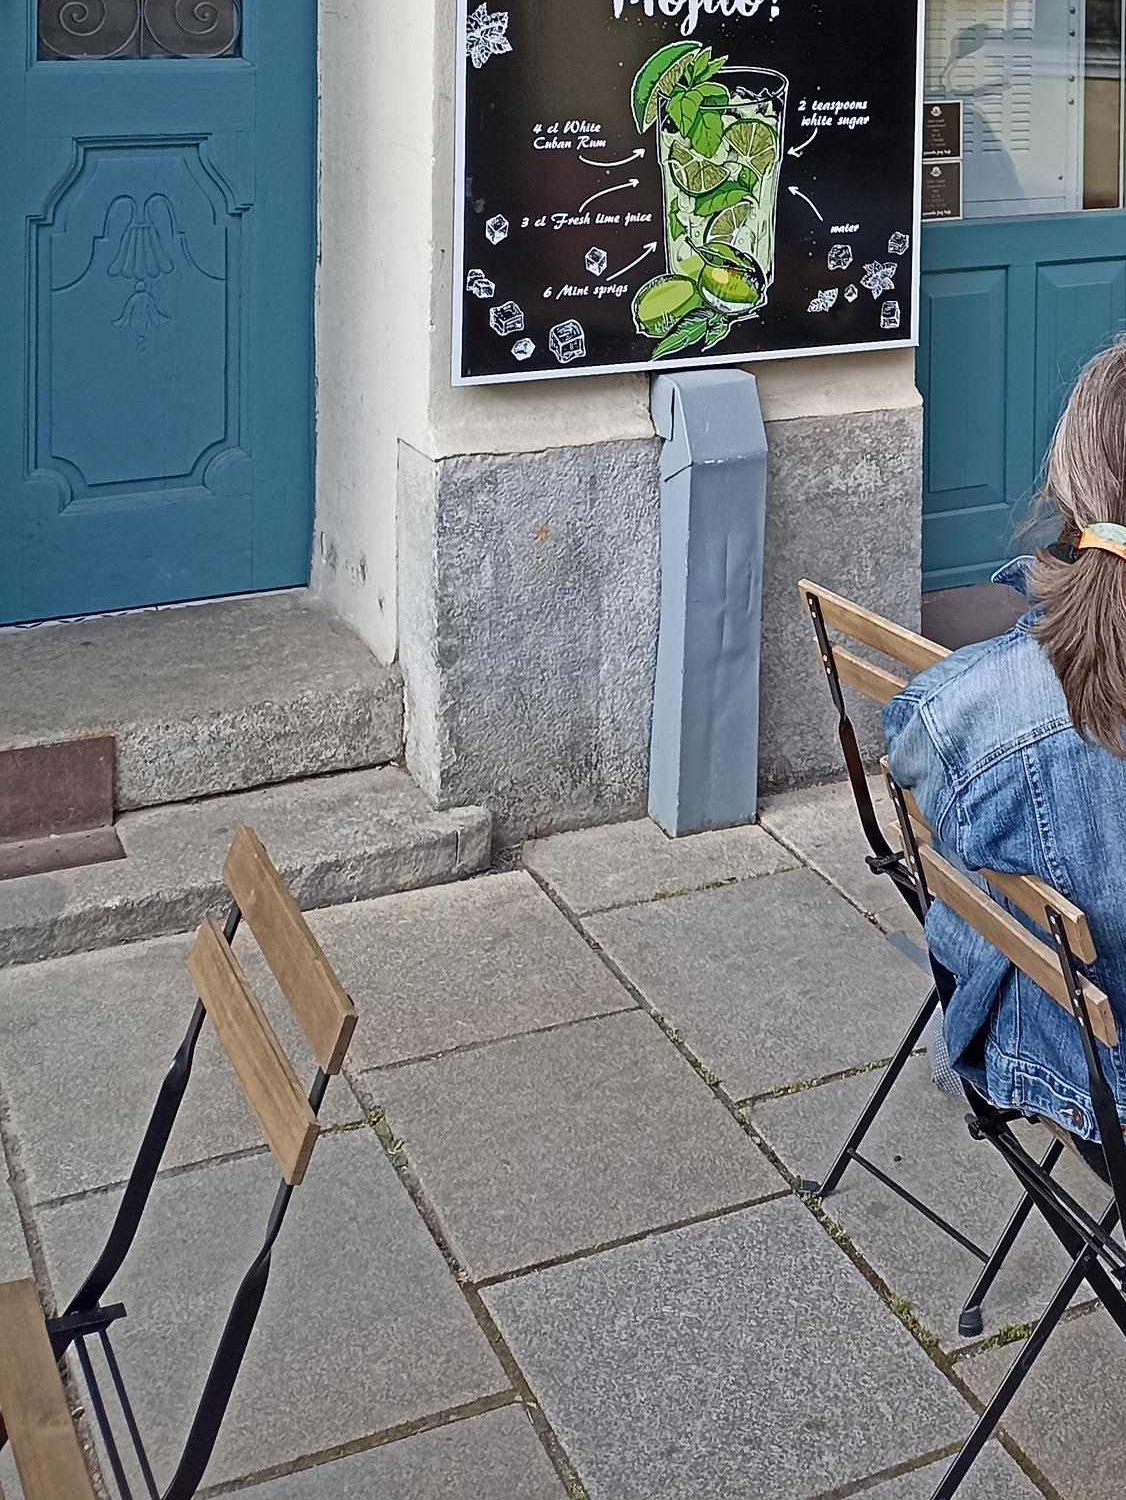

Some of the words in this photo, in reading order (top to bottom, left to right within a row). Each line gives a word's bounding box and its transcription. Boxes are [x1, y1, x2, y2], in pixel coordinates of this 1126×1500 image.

[798, 101, 807, 112] 2
[810, 99, 868, 115] teaspoons
[532, 124, 544, 135] 4
[546, 122, 560, 135] cl
[563, 121, 602, 135] White
[801, 113, 833, 127] white
[837, 113, 870, 128] sugar
[532, 135, 573, 150] Cuban
[576, 134, 607, 149] Rum
[520, 216, 532, 228] 3
[534, 214, 547, 228] cl
[551, 211, 591, 230] Fresh
[595, 213, 621, 225] lime
[623, 211, 653, 229] juice
[830, 223, 860, 234] water
[542, 287, 552, 299] 6
[556, 283, 591, 300] Mint
[594, 282, 630, 300] sprigs
